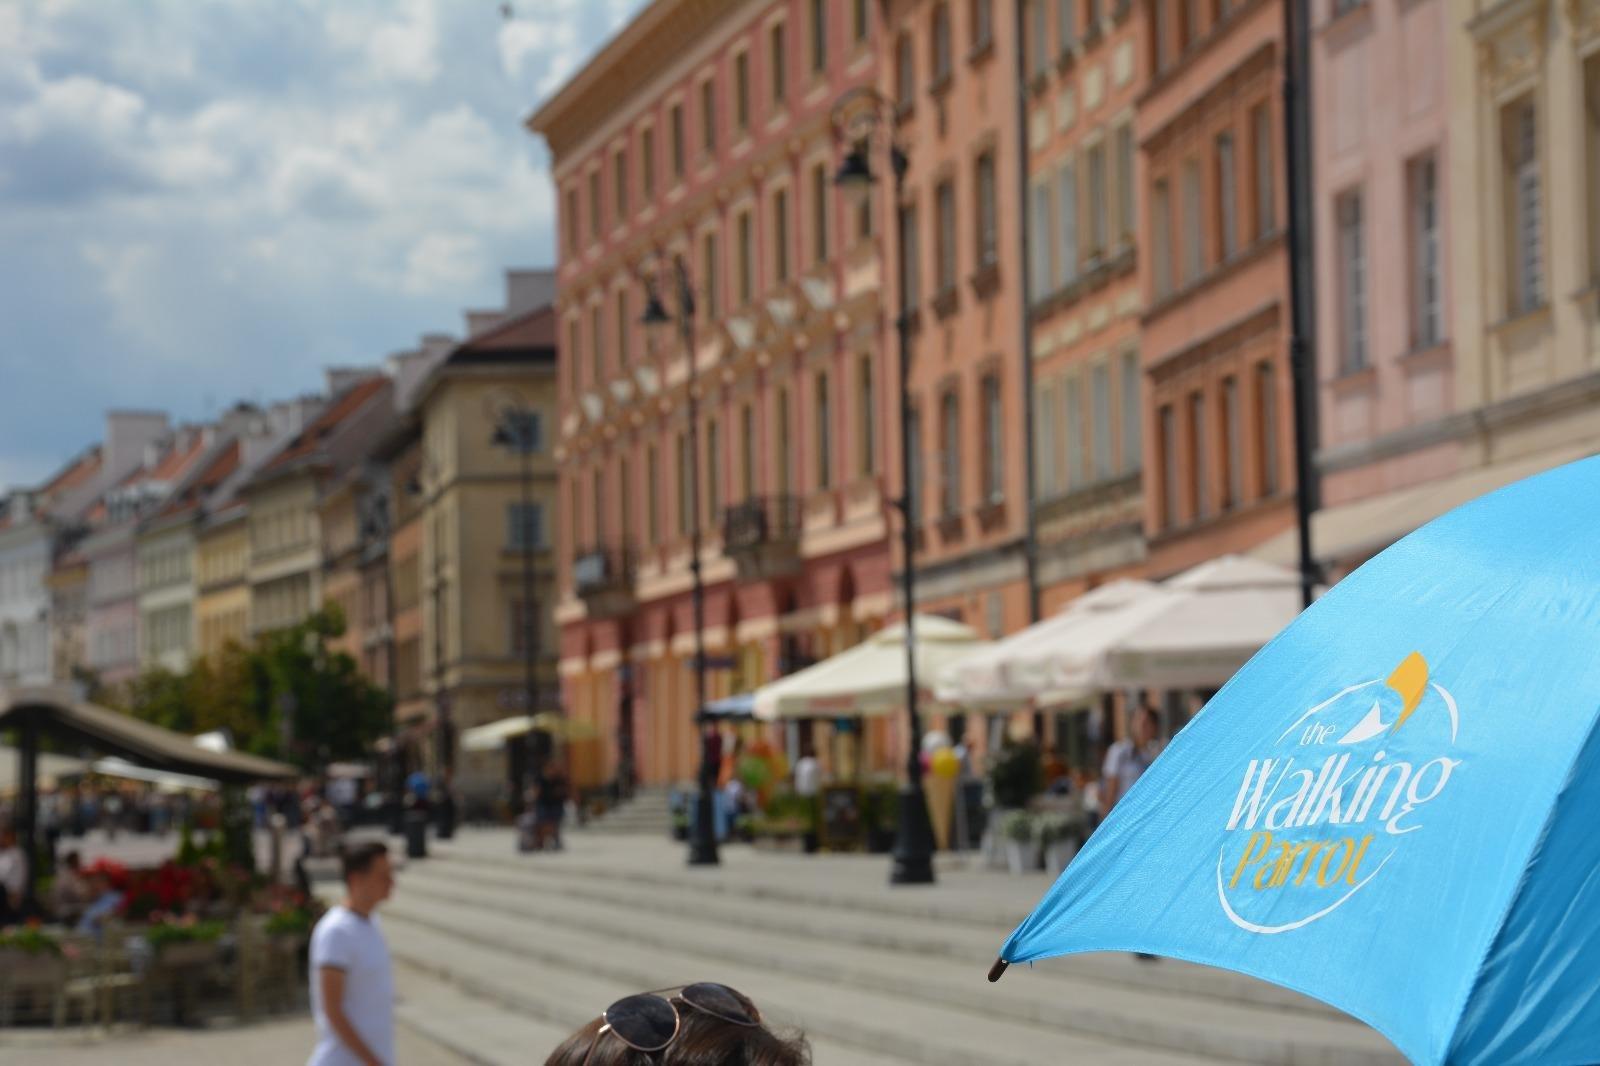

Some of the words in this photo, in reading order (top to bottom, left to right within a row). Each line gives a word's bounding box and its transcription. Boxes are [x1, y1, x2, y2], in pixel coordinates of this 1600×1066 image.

[1300, 720, 1336, 746] the
[1226, 751, 1462, 833] Walking
[1229, 832, 1375, 889] Parrot
